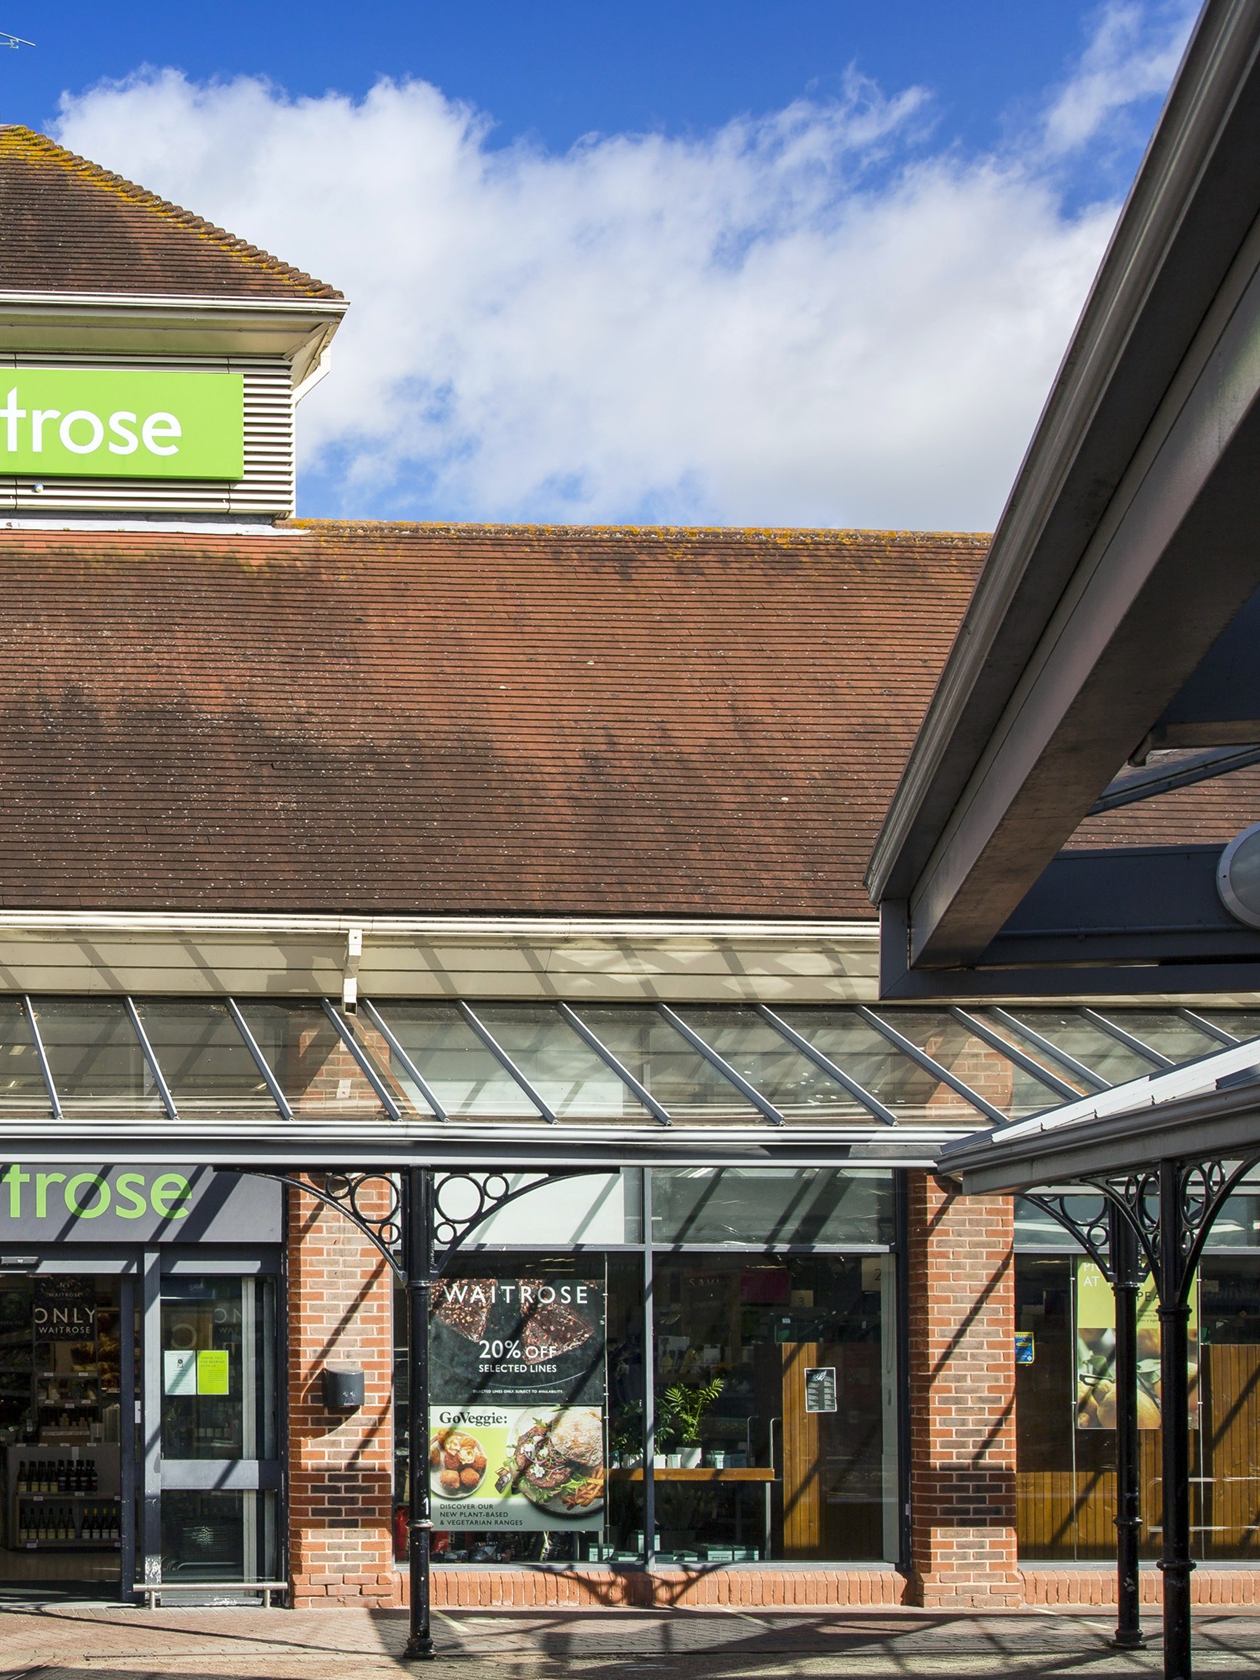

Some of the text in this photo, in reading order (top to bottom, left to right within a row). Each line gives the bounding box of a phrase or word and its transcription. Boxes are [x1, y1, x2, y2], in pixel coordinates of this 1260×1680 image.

[1083, 1275, 1100, 1287] AT
[443, 1286, 588, 1304] WAITROSE
[34, 1307, 96, 1324] ONLY
[38, 1326, 91, 1334] WAITROSE
[479, 1340, 557, 1359] 20% OFF
[479, 1364, 557, 1373] SELECTED LINES
[439, 1411, 508, 1427] GoVeggie:
